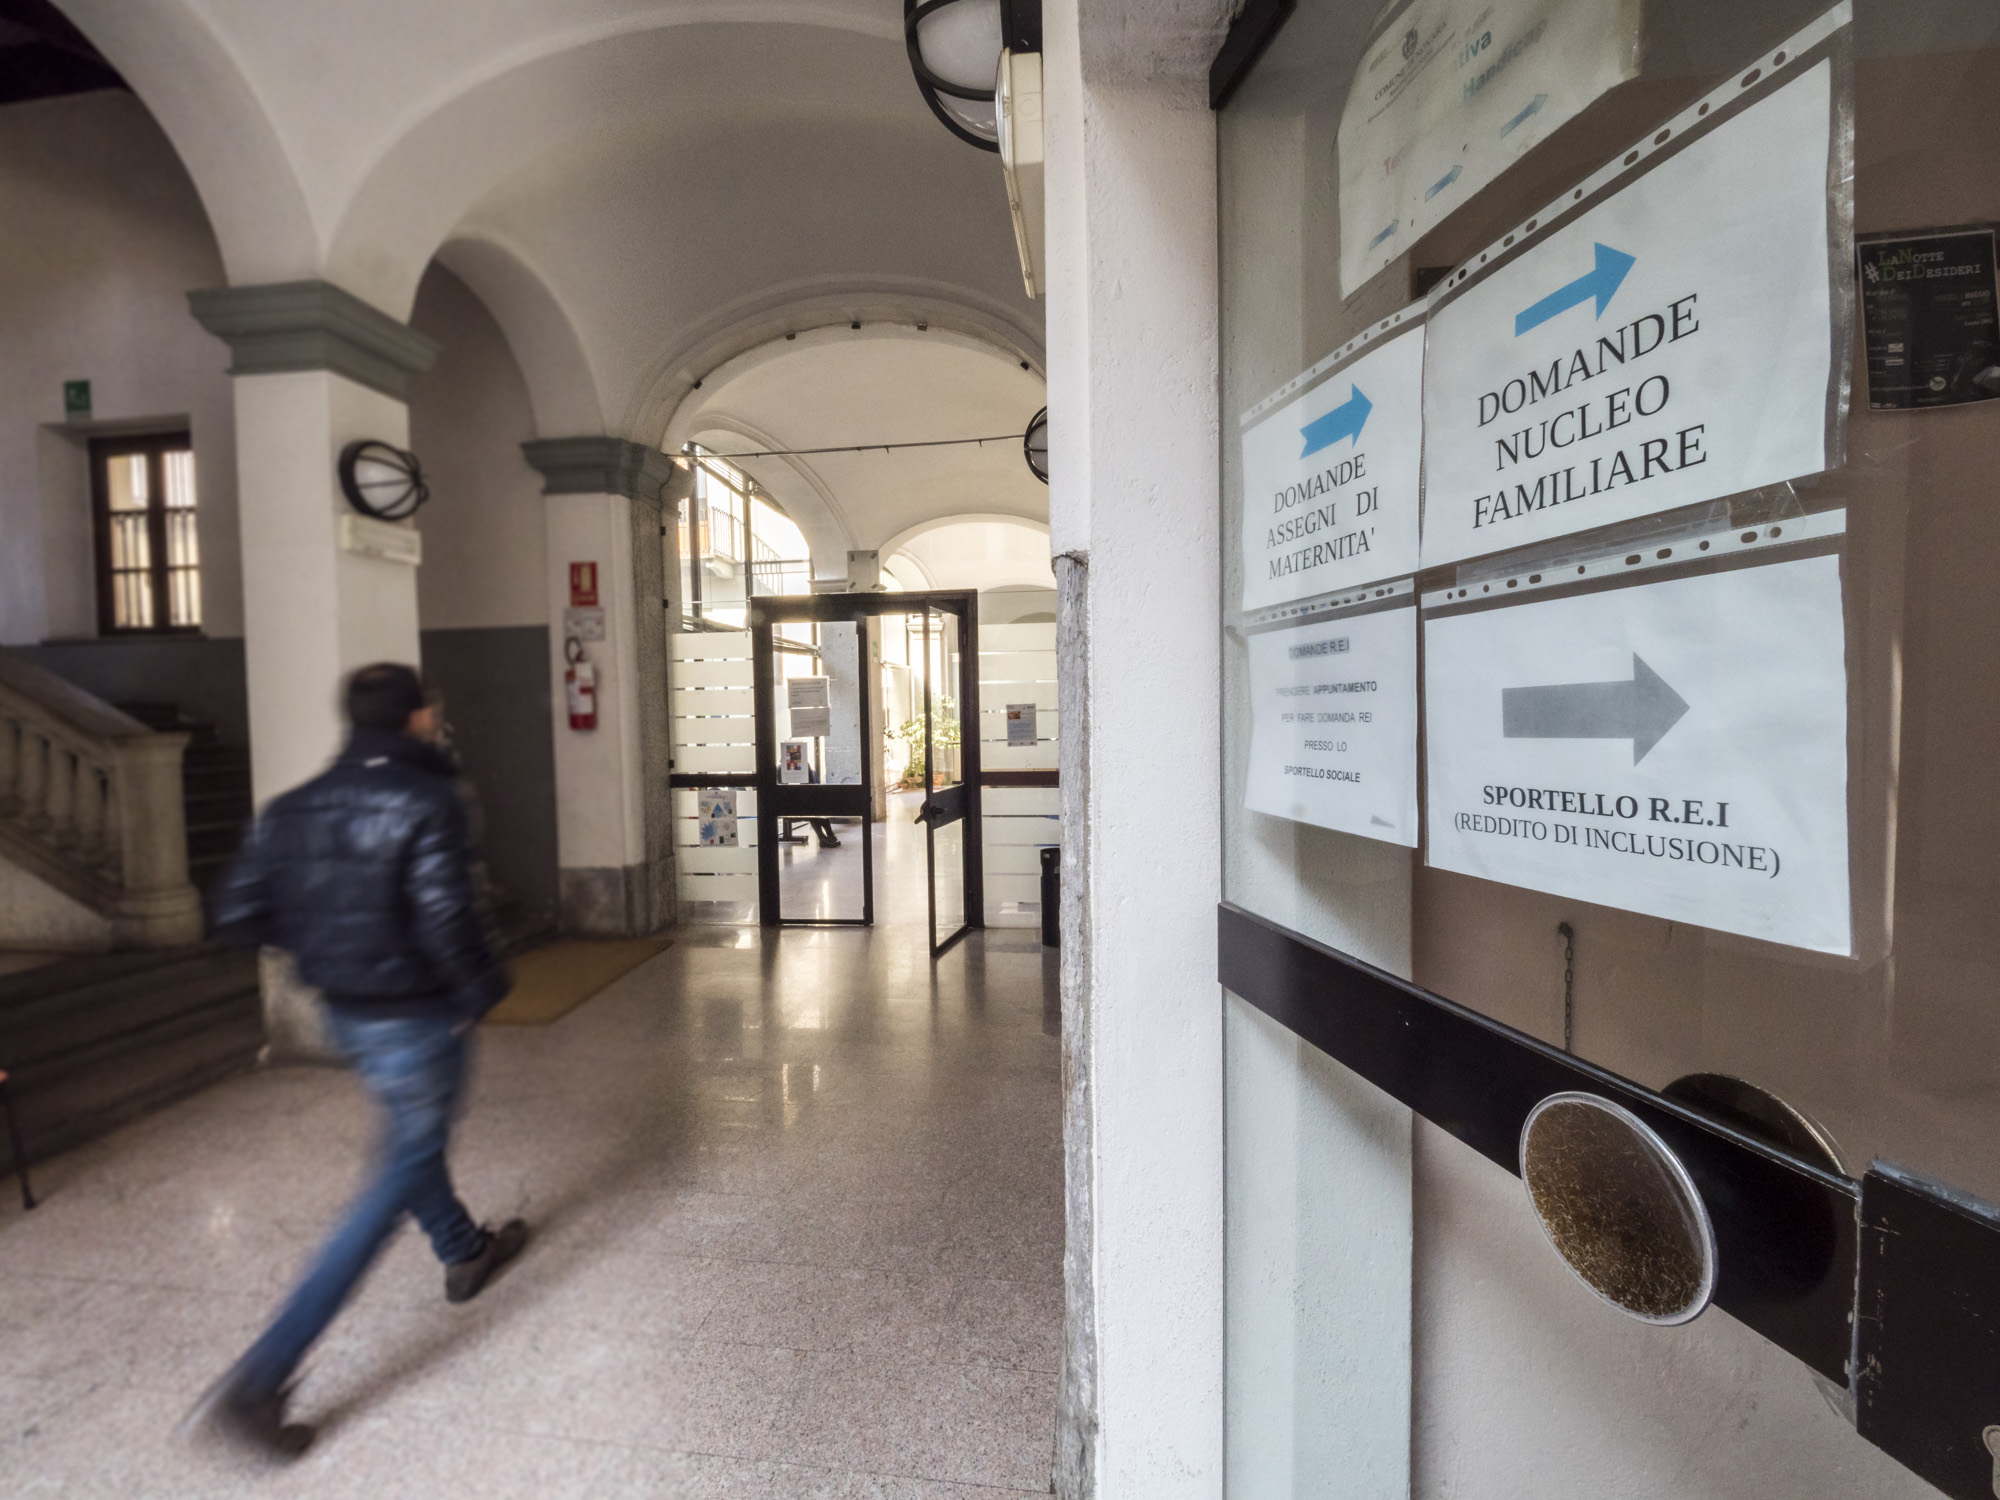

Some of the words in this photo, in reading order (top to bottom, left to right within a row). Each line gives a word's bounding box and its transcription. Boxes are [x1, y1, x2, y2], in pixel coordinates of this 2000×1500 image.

[1477, 293, 1699, 427] DOMANDE
[1495, 375, 1670, 471] NUCLEO
[1274, 454, 1366, 513] DOMANDE
[1473, 424, 1707, 529] FAMILIARE
[1267, 503, 1336, 549] ASSEGNI
[1356, 486, 1379, 516] DI
[1268, 527, 1375, 580] MATERNITA'
[1313, 681, 1377, 695] APPUNTAMENTO
[1282, 713, 1294, 723] PER
[1297, 713, 1314, 723] FARE
[1318, 712, 1355, 723] DOMANDA
[1359, 712, 1372, 723] REI
[1284, 765, 1325, 779] SPORTELLO
[1326, 769, 1360, 782] SOCIALE
[1304, 740, 1333, 751] PRESSO
[1337, 741, 1347, 752] LO
[1483, 785, 1638, 819] SPORTELLO
[1648, 797, 1730, 828] R.E.I
[1454, 811, 1547, 841] (REDDITO
[1554, 823, 1577, 845] DI
[1585, 827, 1781, 879] INCLUSIONE)
